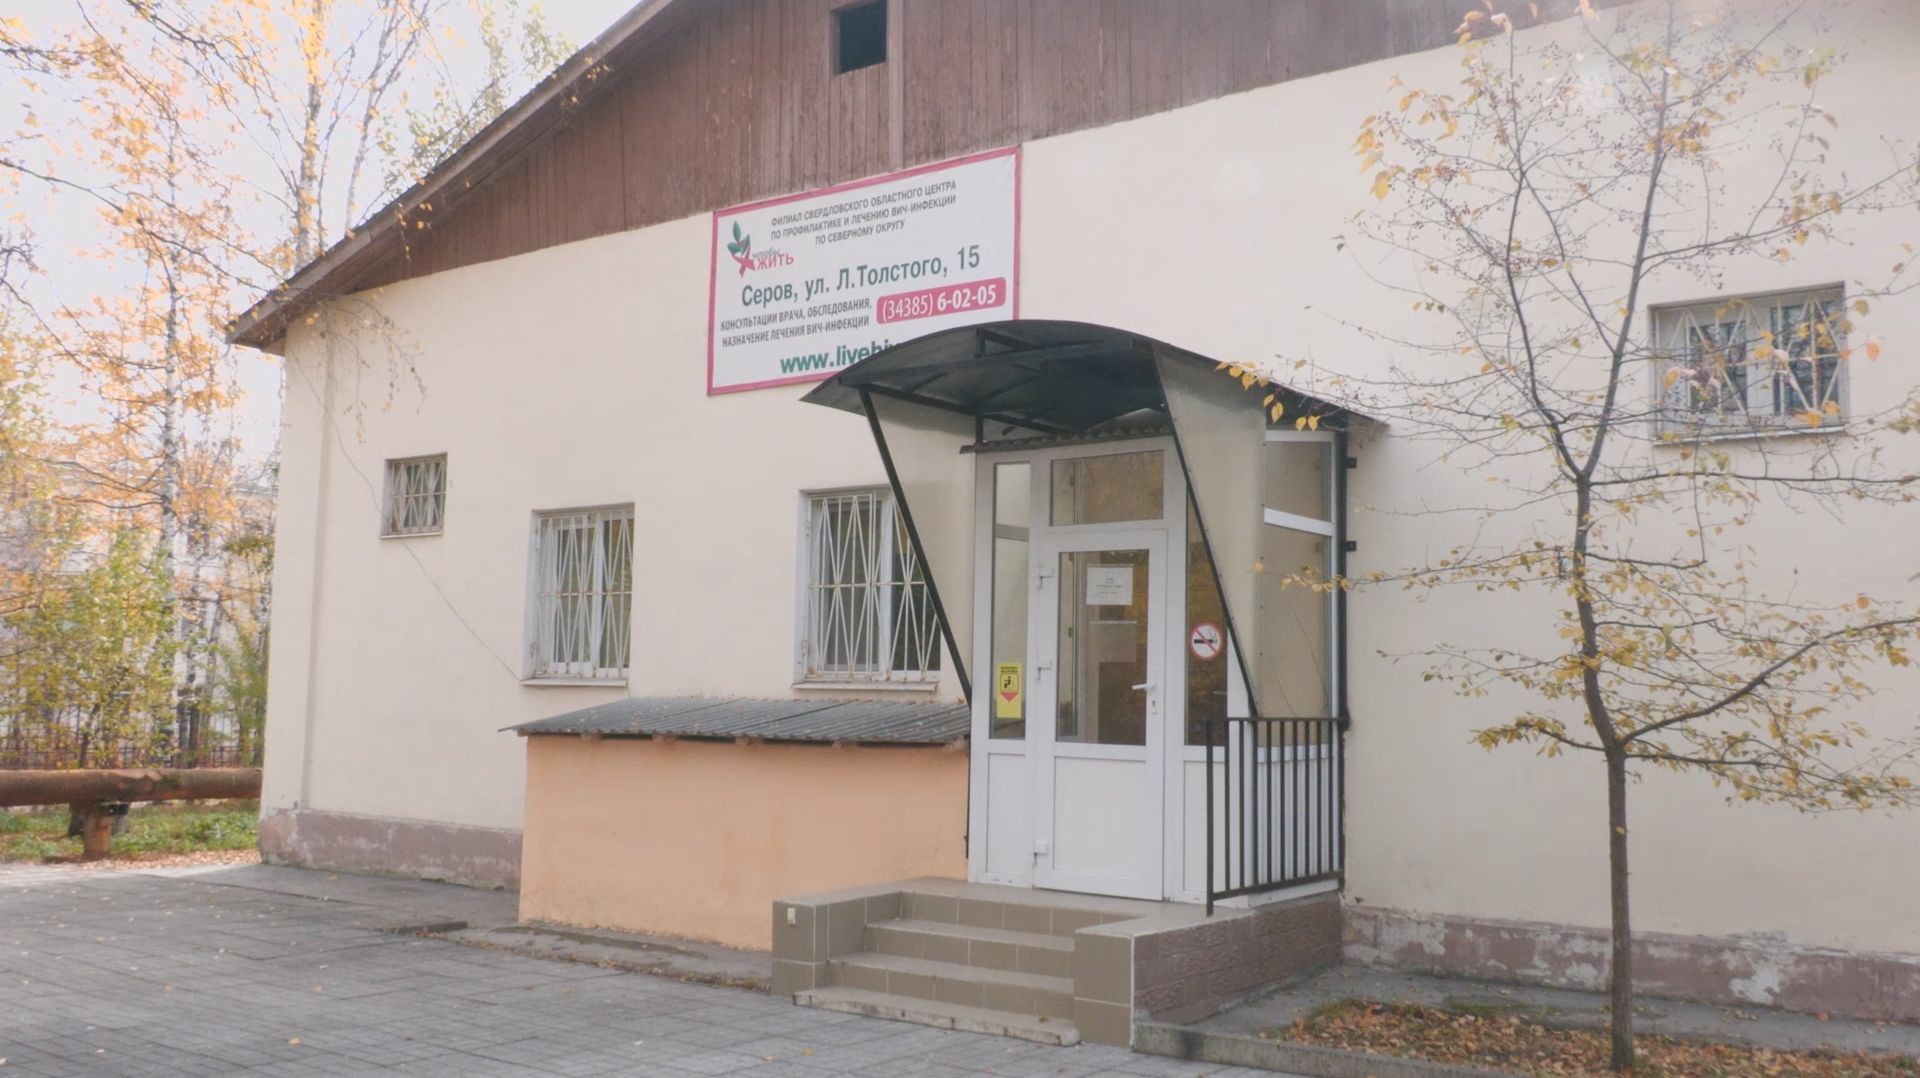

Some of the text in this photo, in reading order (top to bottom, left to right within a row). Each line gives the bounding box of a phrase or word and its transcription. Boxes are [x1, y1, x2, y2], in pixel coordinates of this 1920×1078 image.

[770, 231, 782, 241] ПО
[783, 222, 842, 237] ПРОФИЛАКТИКЕ
[851, 208, 890, 225] ЛЕЧЕНИЮ
[891, 194, 957, 217] ВИЧ-ИНФЕКЦИИ
[771, 180, 957, 227] ФИЛИАЛ СВЕРДЛОВСКОГО ОБЛАСТНОГО ЦЕНТРА
[815, 219, 905, 245] ПО СЕВЕРНОМУ ОКРУГУ
[742, 244, 980, 309] Серов, ул. Л.Толстого, 15
[757, 252, 795, 271] ЖИТЬ
[720, 298, 872, 332] КОНСУЛЬТАЦИИ ВРАЧА, ОБСЛЕДОВАНИЯ,
[882, 284, 998, 323] (34385) 6-02-05
[722, 314, 870, 349] НАЗНАЧЕНИЕ ЛЕЧЕНИЯ ВИЧ-ИНФЕКЦИИ
[780, 339, 895, 374] www.liveh
